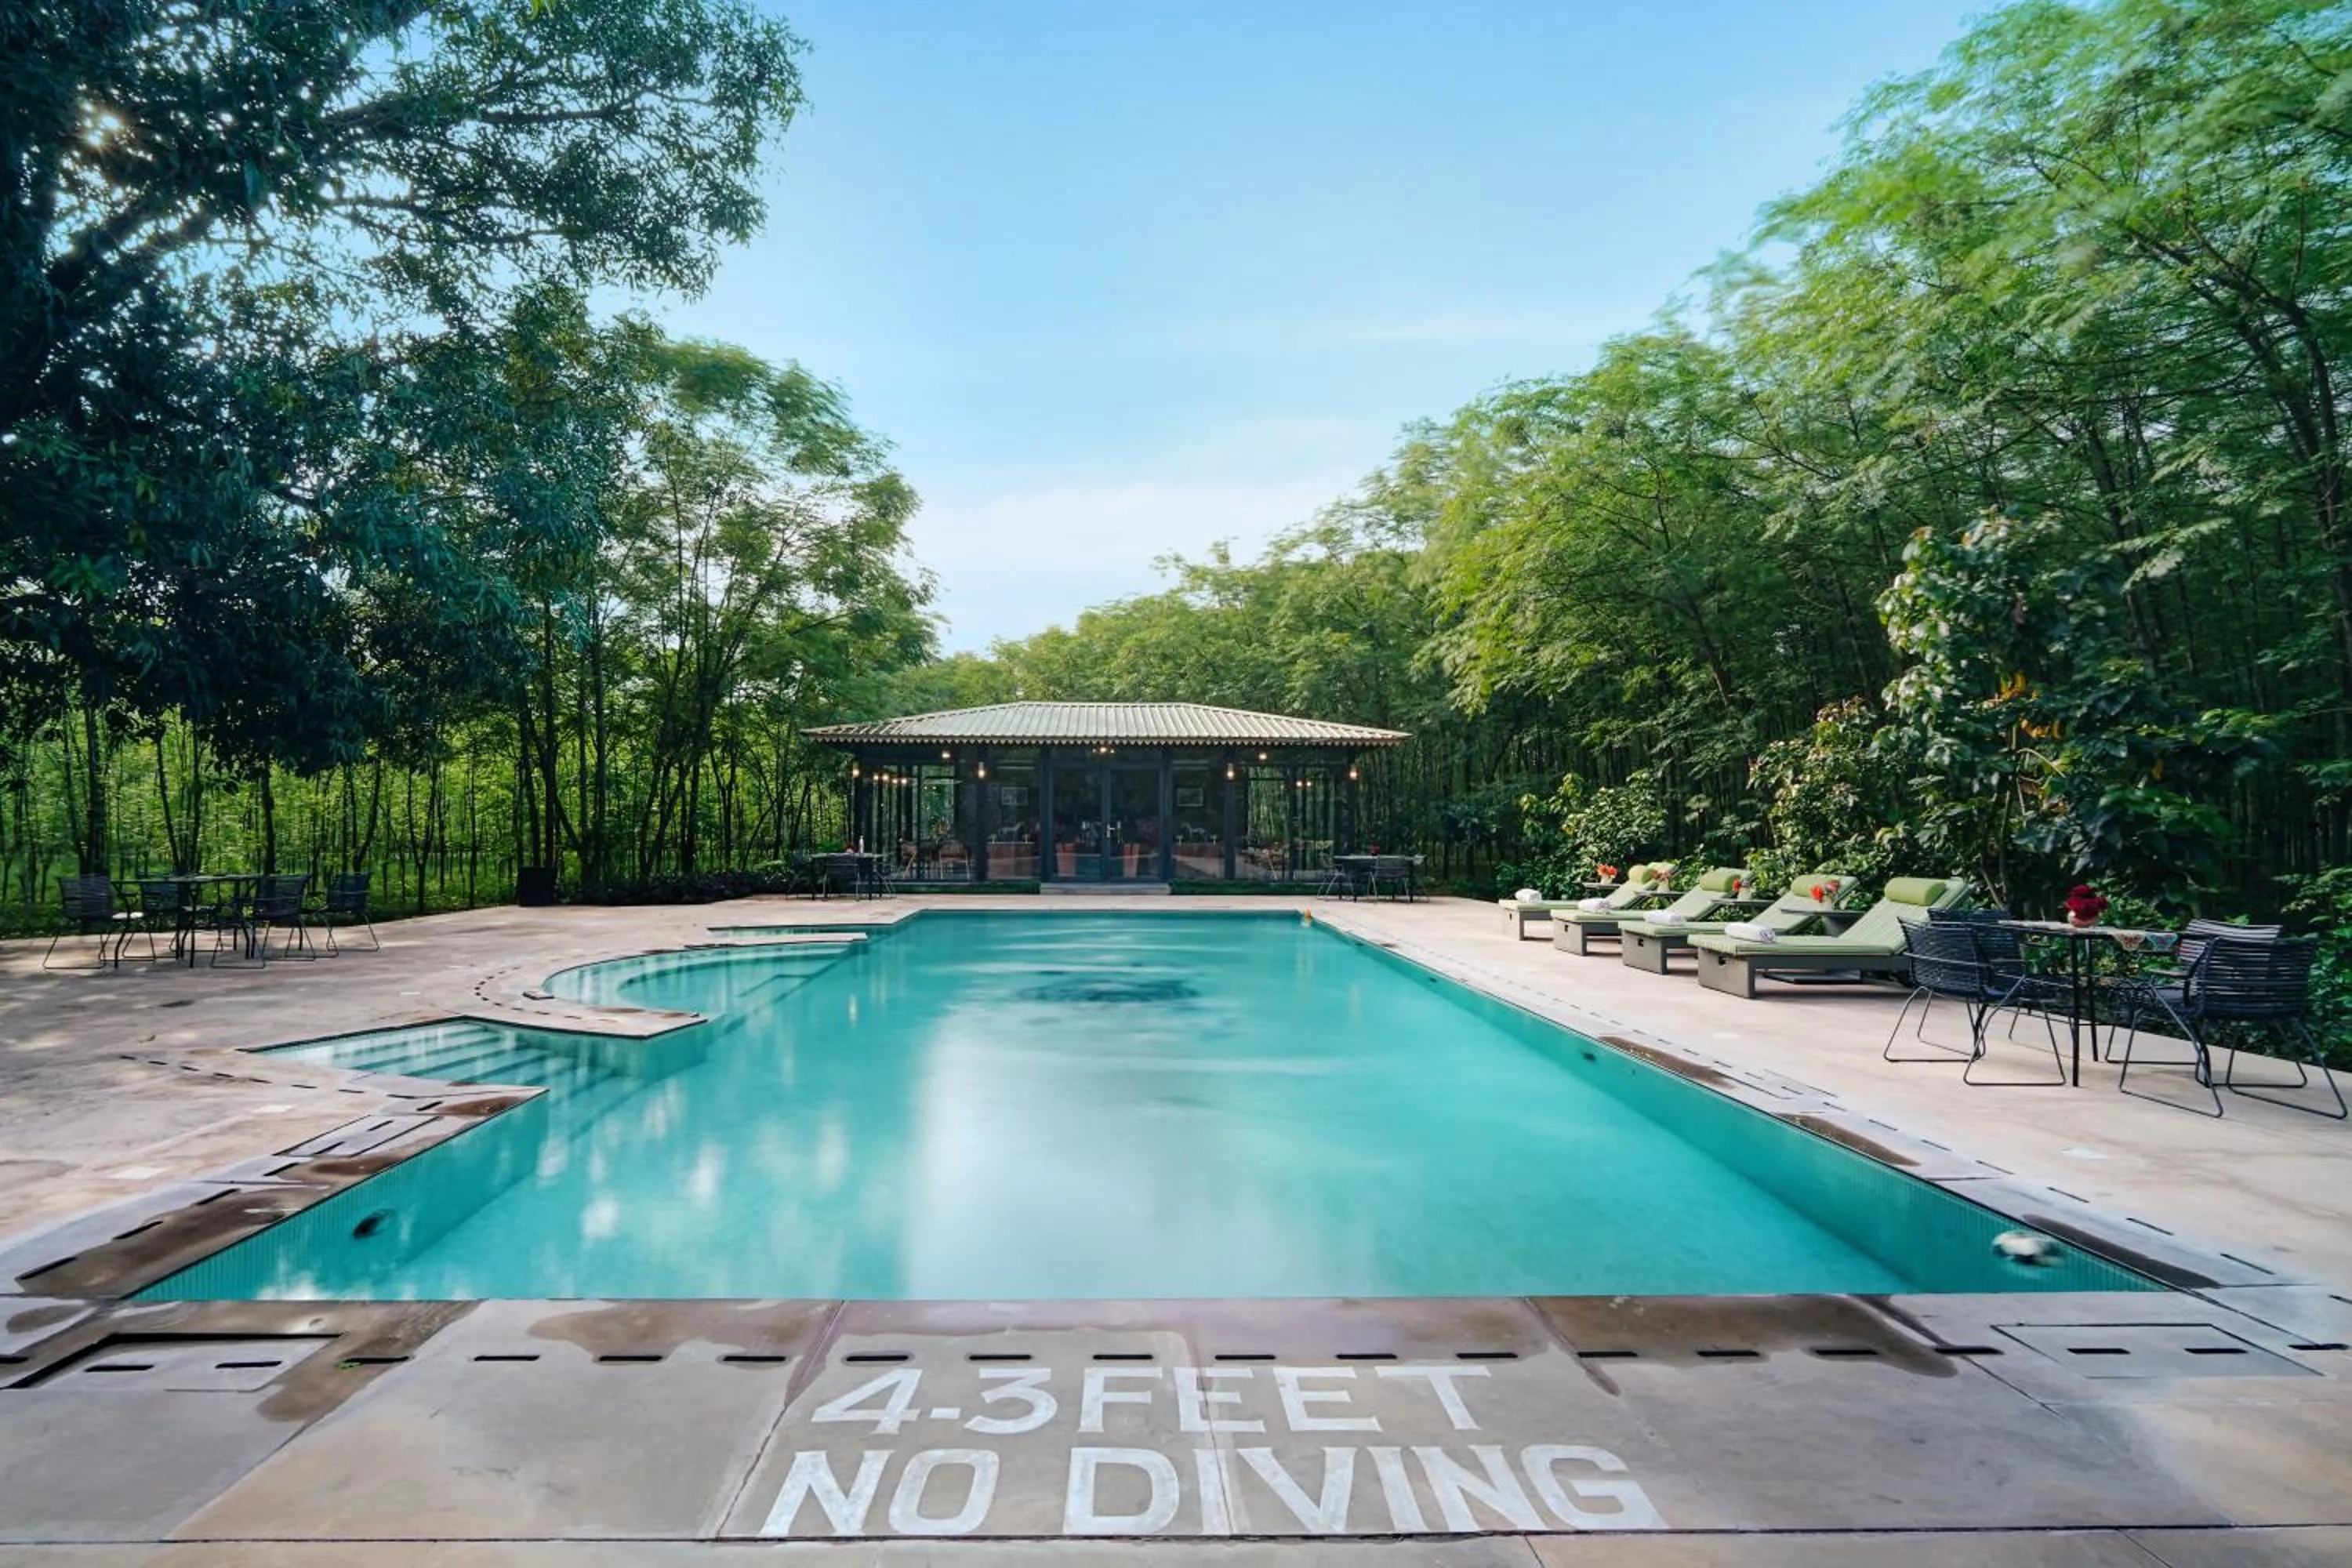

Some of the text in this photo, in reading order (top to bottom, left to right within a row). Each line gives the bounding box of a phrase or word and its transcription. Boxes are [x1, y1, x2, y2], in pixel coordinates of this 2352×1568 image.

[1078, 1366, 1492, 1433] FEET
[760, 1444, 1668, 1537] NO DIVING
